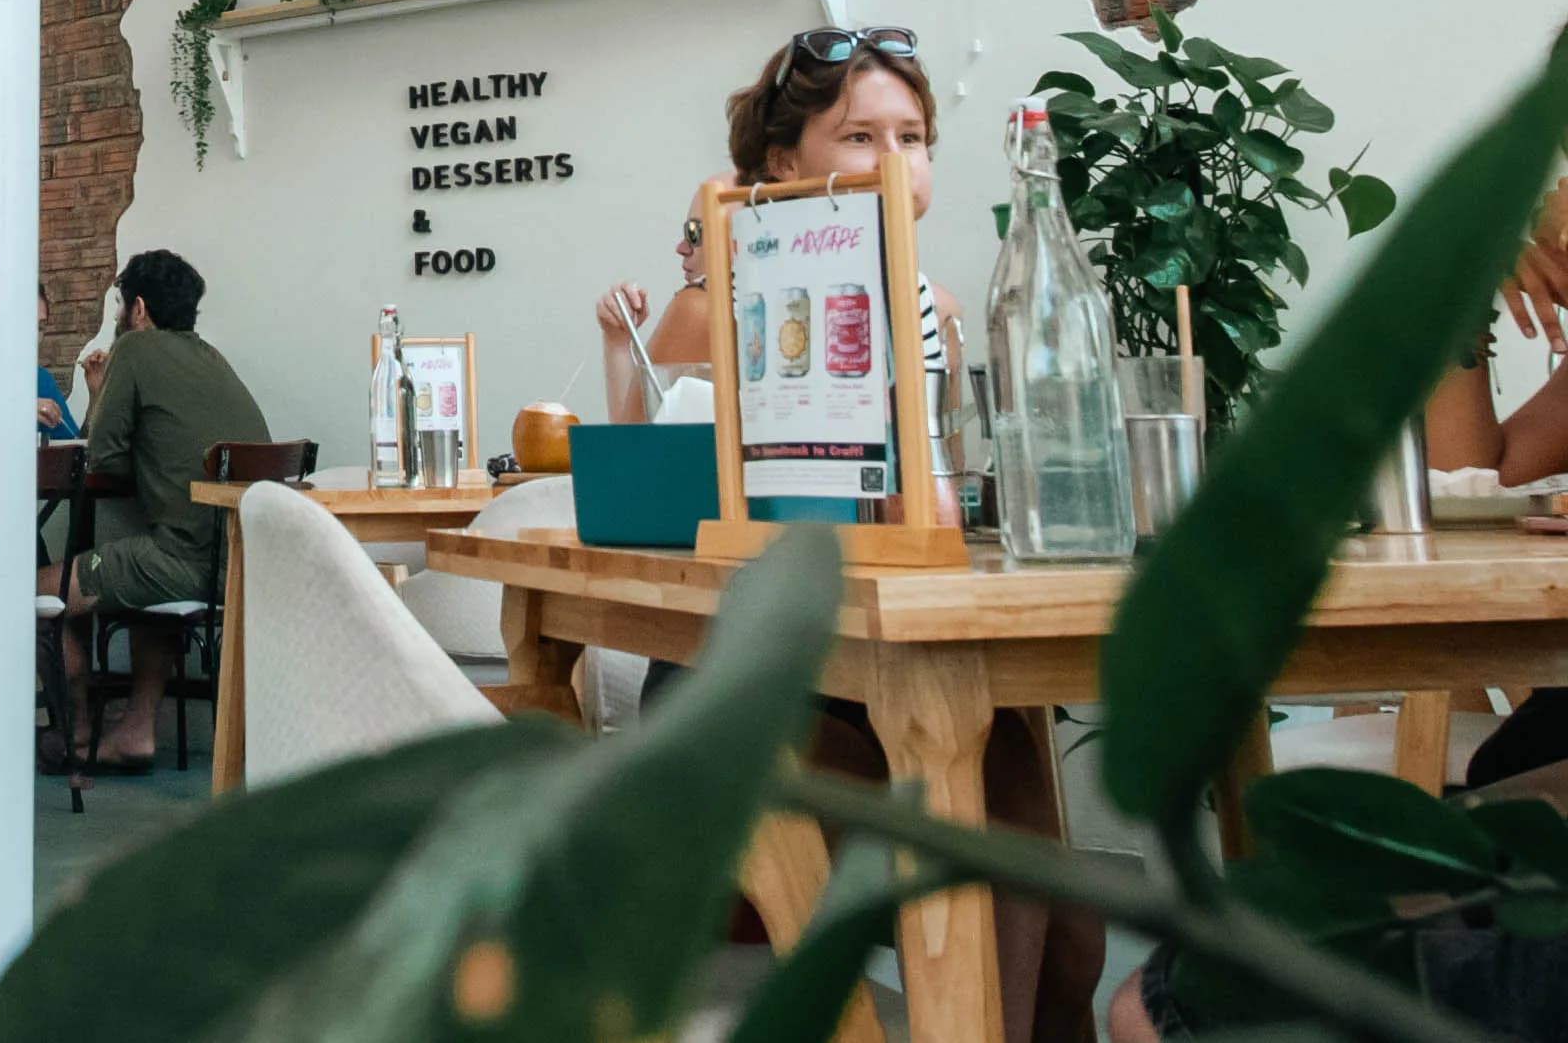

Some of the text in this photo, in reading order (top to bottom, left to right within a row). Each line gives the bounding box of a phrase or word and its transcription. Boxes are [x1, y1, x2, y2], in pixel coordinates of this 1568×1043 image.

[408, 71, 548, 109] HEALTHY
[410, 116, 517, 149] VEGAN
[412, 153, 574, 190] DESSERTS
[412, 209, 432, 233] &
[414, 247, 496, 276] FOOD
